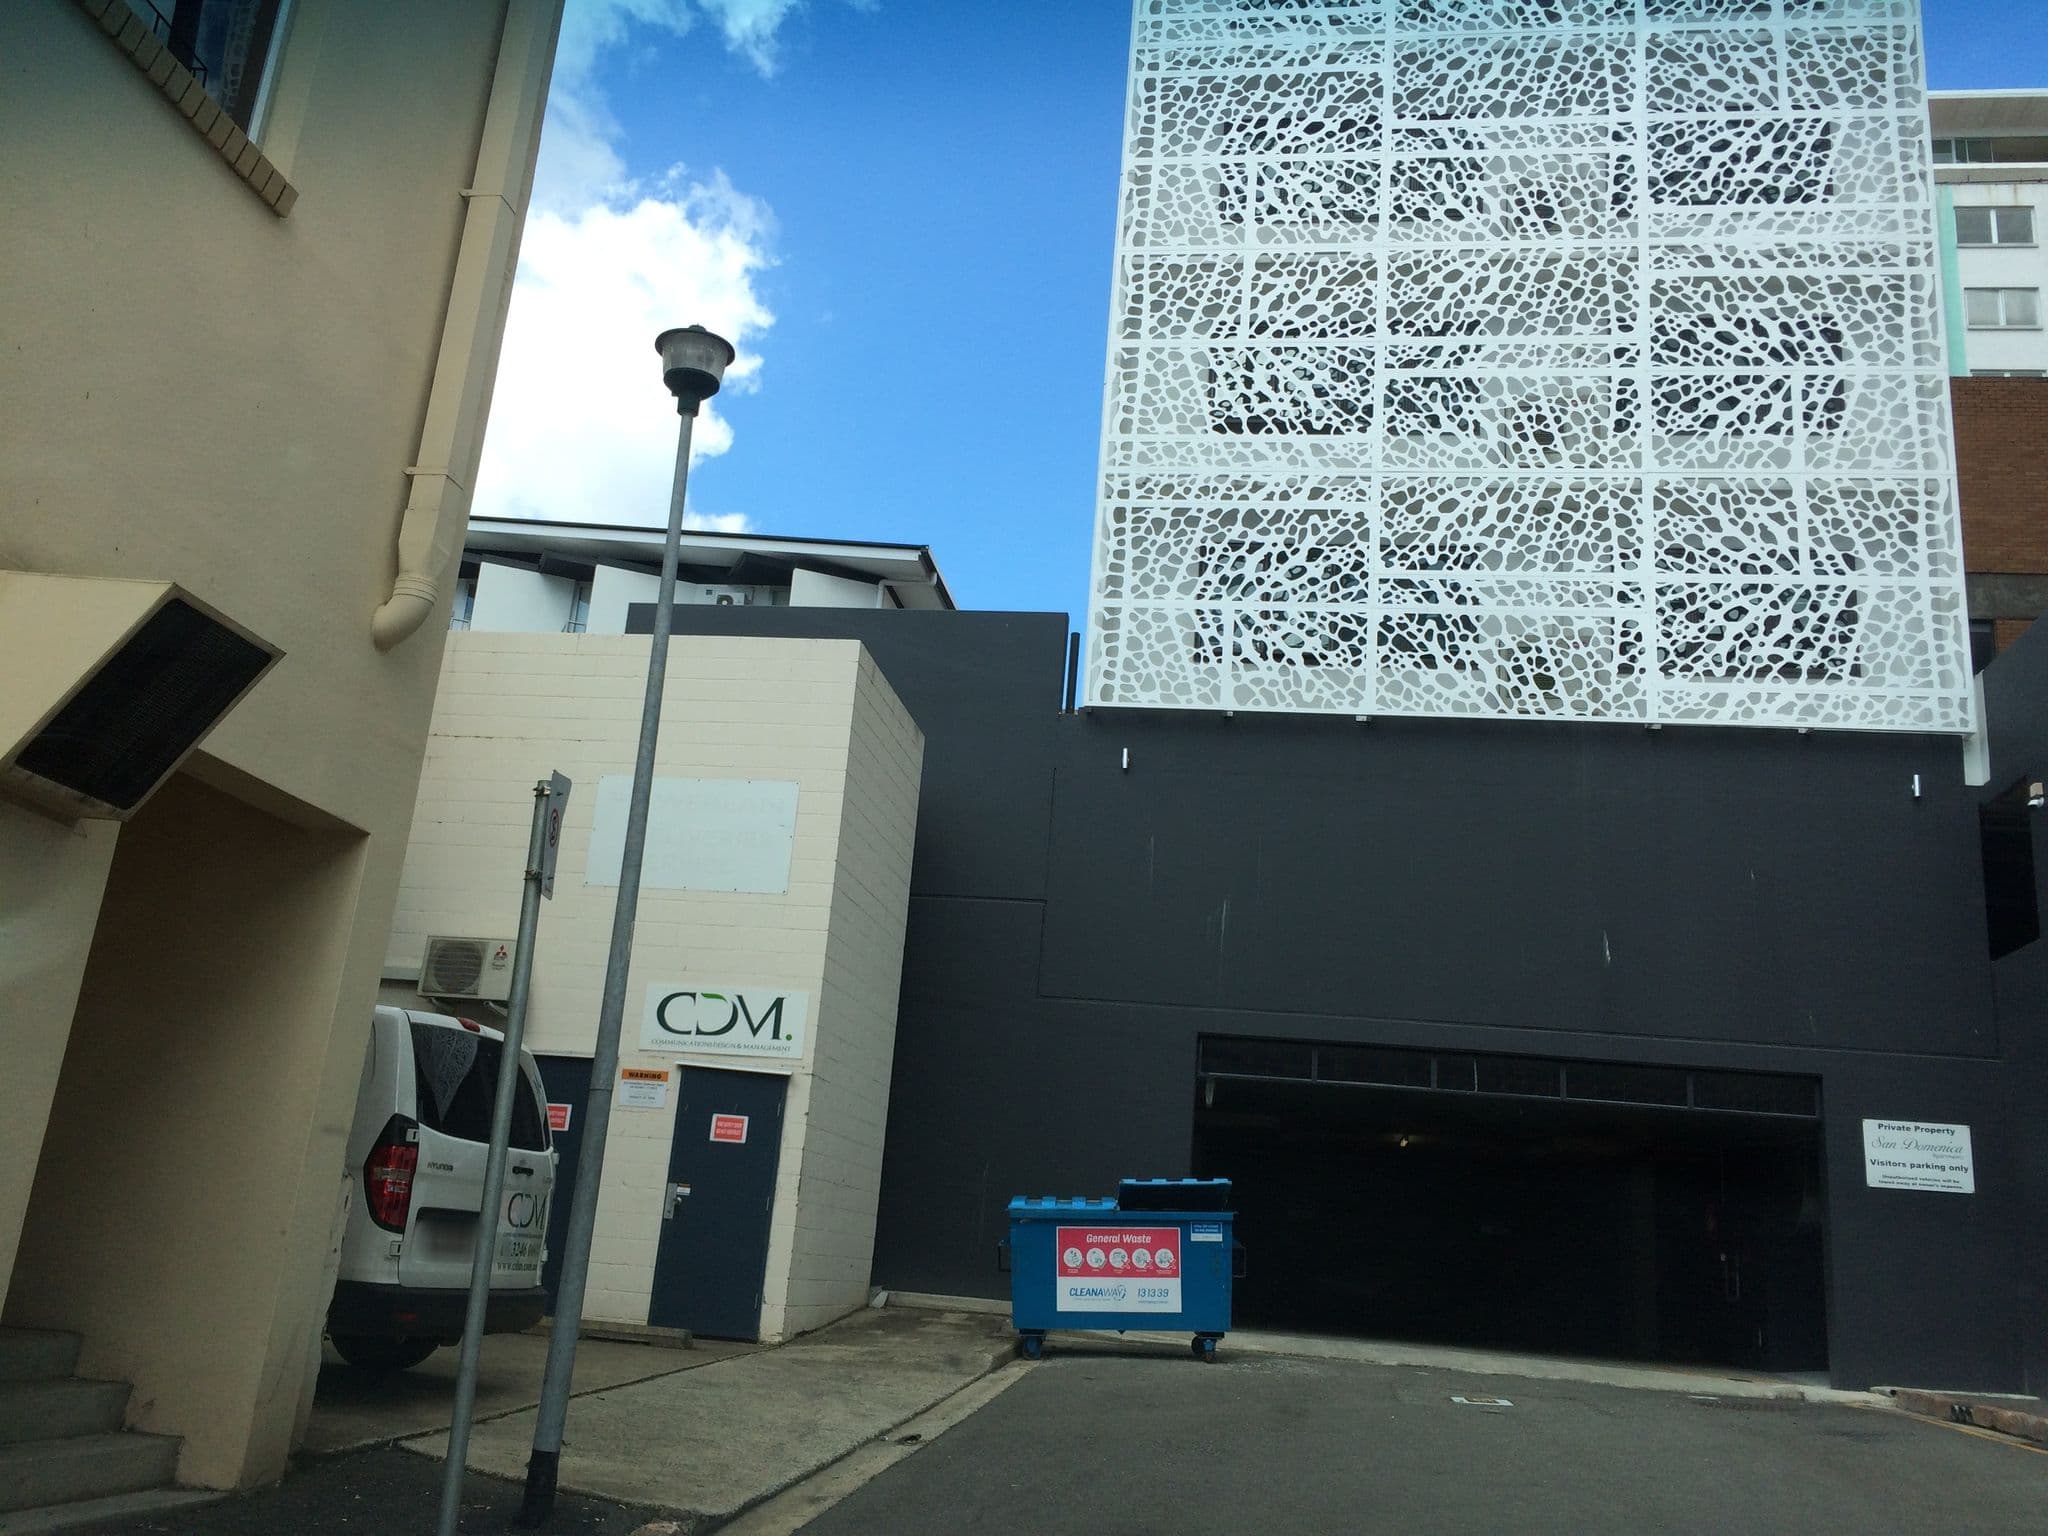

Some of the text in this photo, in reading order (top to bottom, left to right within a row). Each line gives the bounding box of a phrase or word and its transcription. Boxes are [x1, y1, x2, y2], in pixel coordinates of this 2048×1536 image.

[628, 1071, 662, 1079] WARNING
[1878, 1123, 1956, 1136] Private Property
[1871, 1136, 1897, 1149] San
[1870, 1158, 1969, 1174] Visitors parking only
[1086, 1233, 1152, 1244] General Waste
[1069, 1287, 1123, 1297] CLEANAWAY
